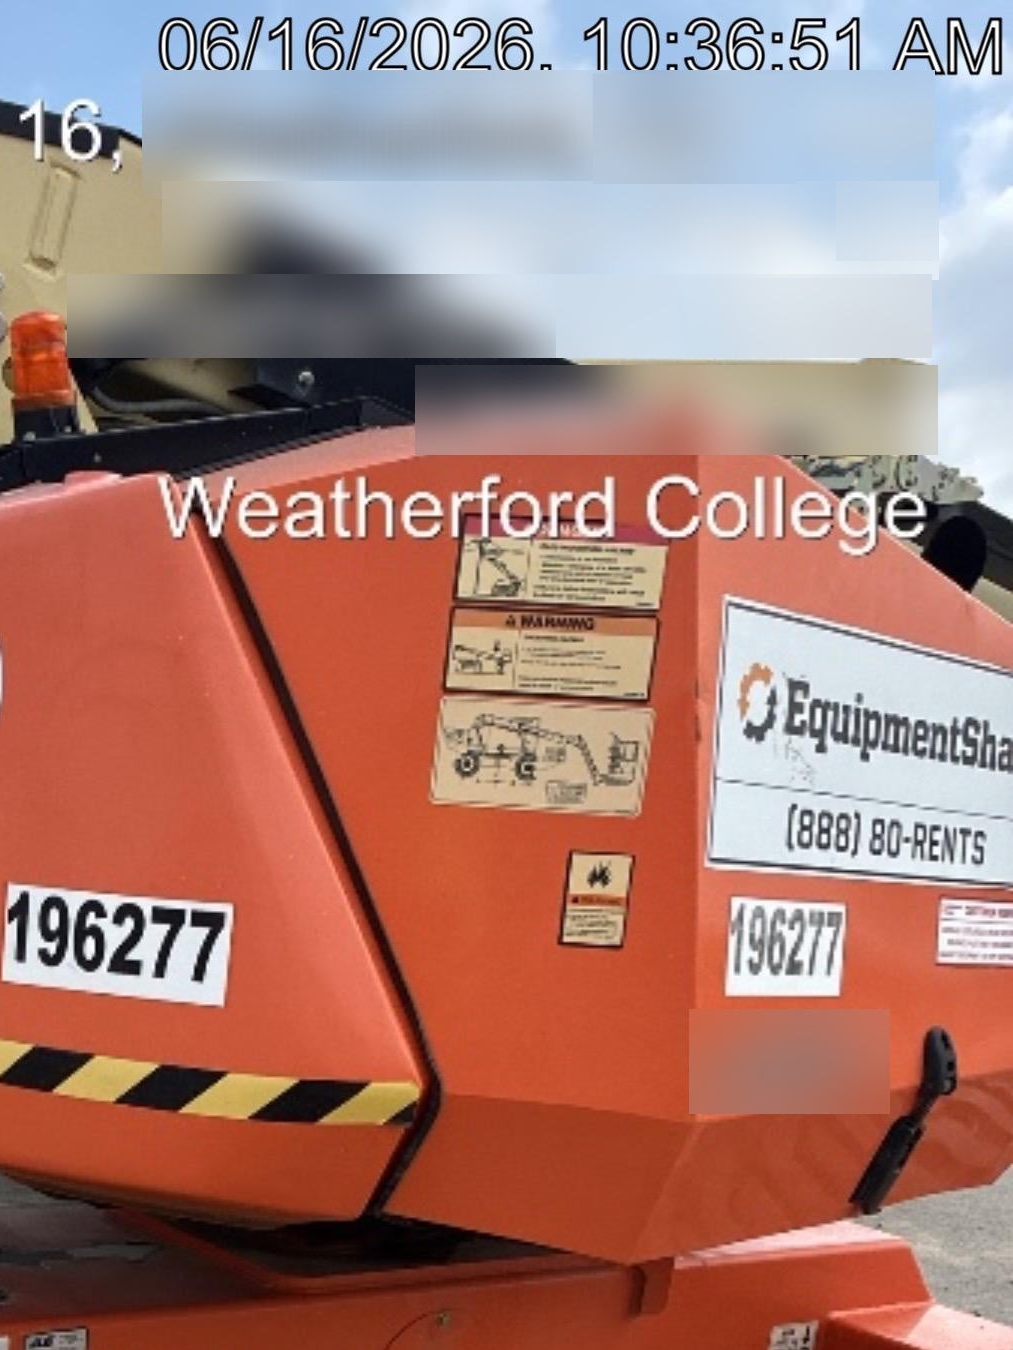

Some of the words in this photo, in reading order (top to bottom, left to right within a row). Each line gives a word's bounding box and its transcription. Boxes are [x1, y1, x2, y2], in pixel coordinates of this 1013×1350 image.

[785, 802, 862, 859] (888)
[868, 817, 987, 866] 80-RENTS
[6, 889, 227, 983] 196277
[730, 901, 844, 977] 196277
